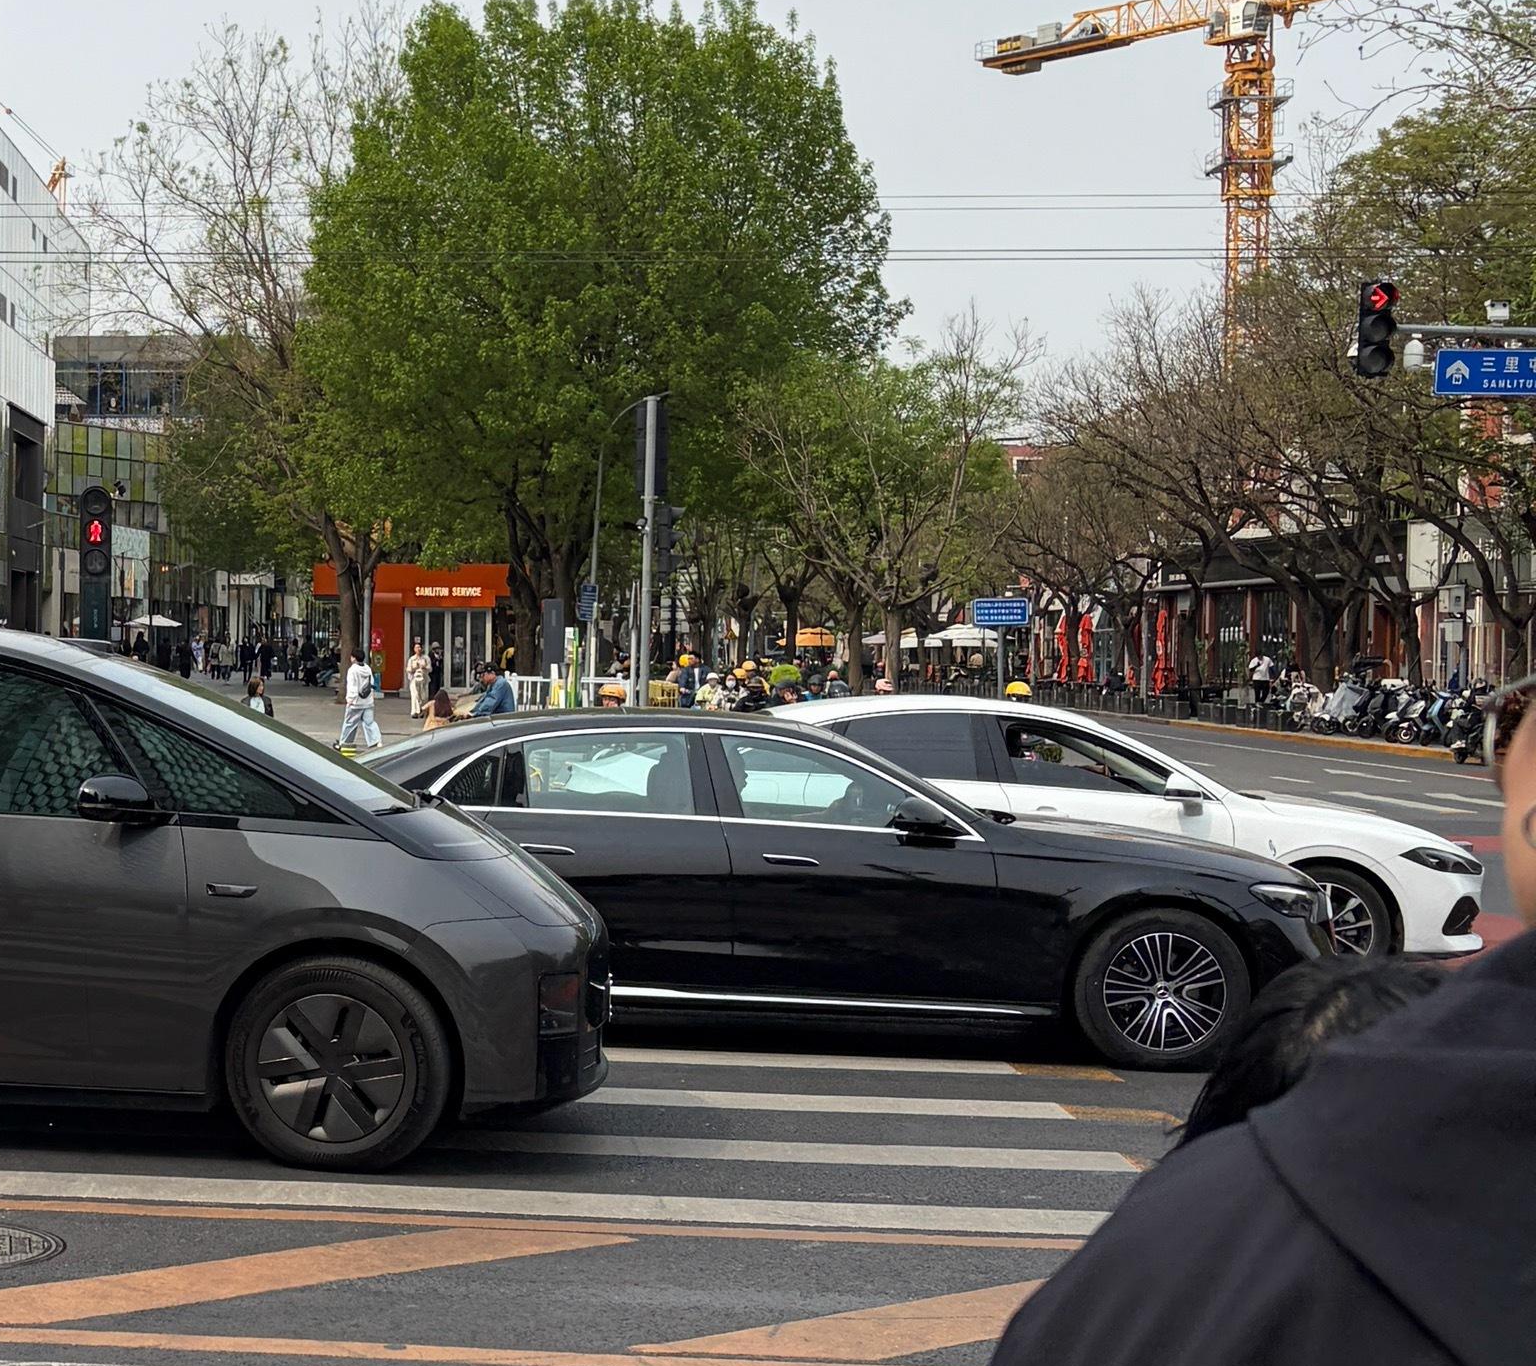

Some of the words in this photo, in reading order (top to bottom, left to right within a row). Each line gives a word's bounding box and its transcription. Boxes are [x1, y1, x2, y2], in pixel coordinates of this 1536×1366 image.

[1482, 379, 1536, 389] SANLITU
[415, 586, 449, 597] SANLITUN
[452, 586, 482, 597] SERVICE
